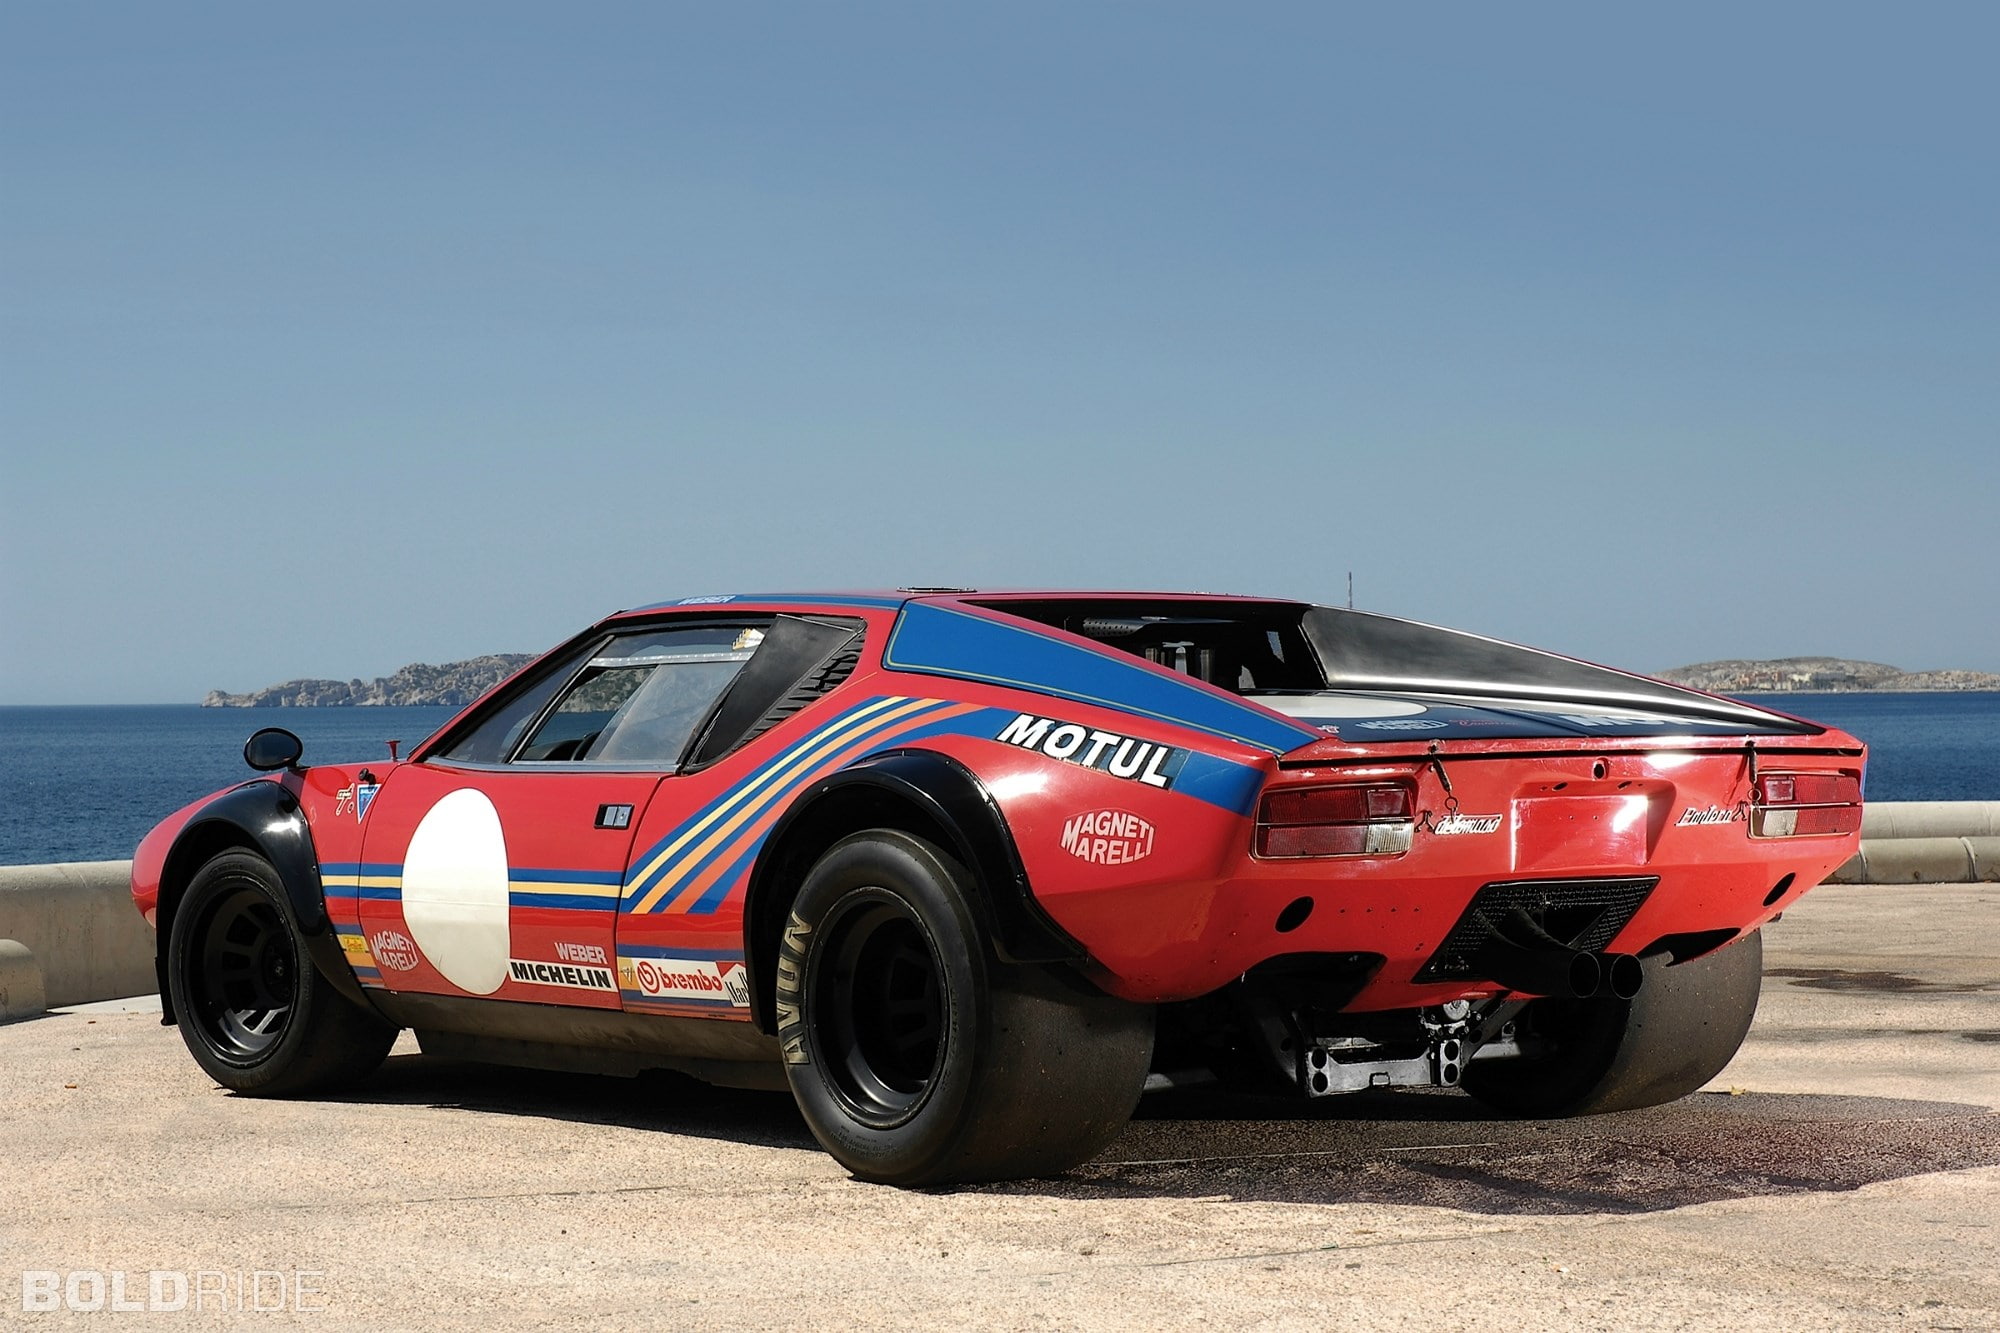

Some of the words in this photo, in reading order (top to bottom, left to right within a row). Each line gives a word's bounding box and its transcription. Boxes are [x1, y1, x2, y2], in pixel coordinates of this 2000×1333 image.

[997, 713, 1169, 788] MOTUL
[1061, 811, 1154, 848] MAGNETI
[1061, 833, 1154, 865] MARELLI
[370, 930, 417, 956] MAGNETI
[554, 942, 608, 965] WEBER
[372, 946, 419, 971] MARELLI
[510, 962, 612, 989] MICHELIN
[658, 966, 723, 991] brembo
[776, 910, 813, 1064] AVON
